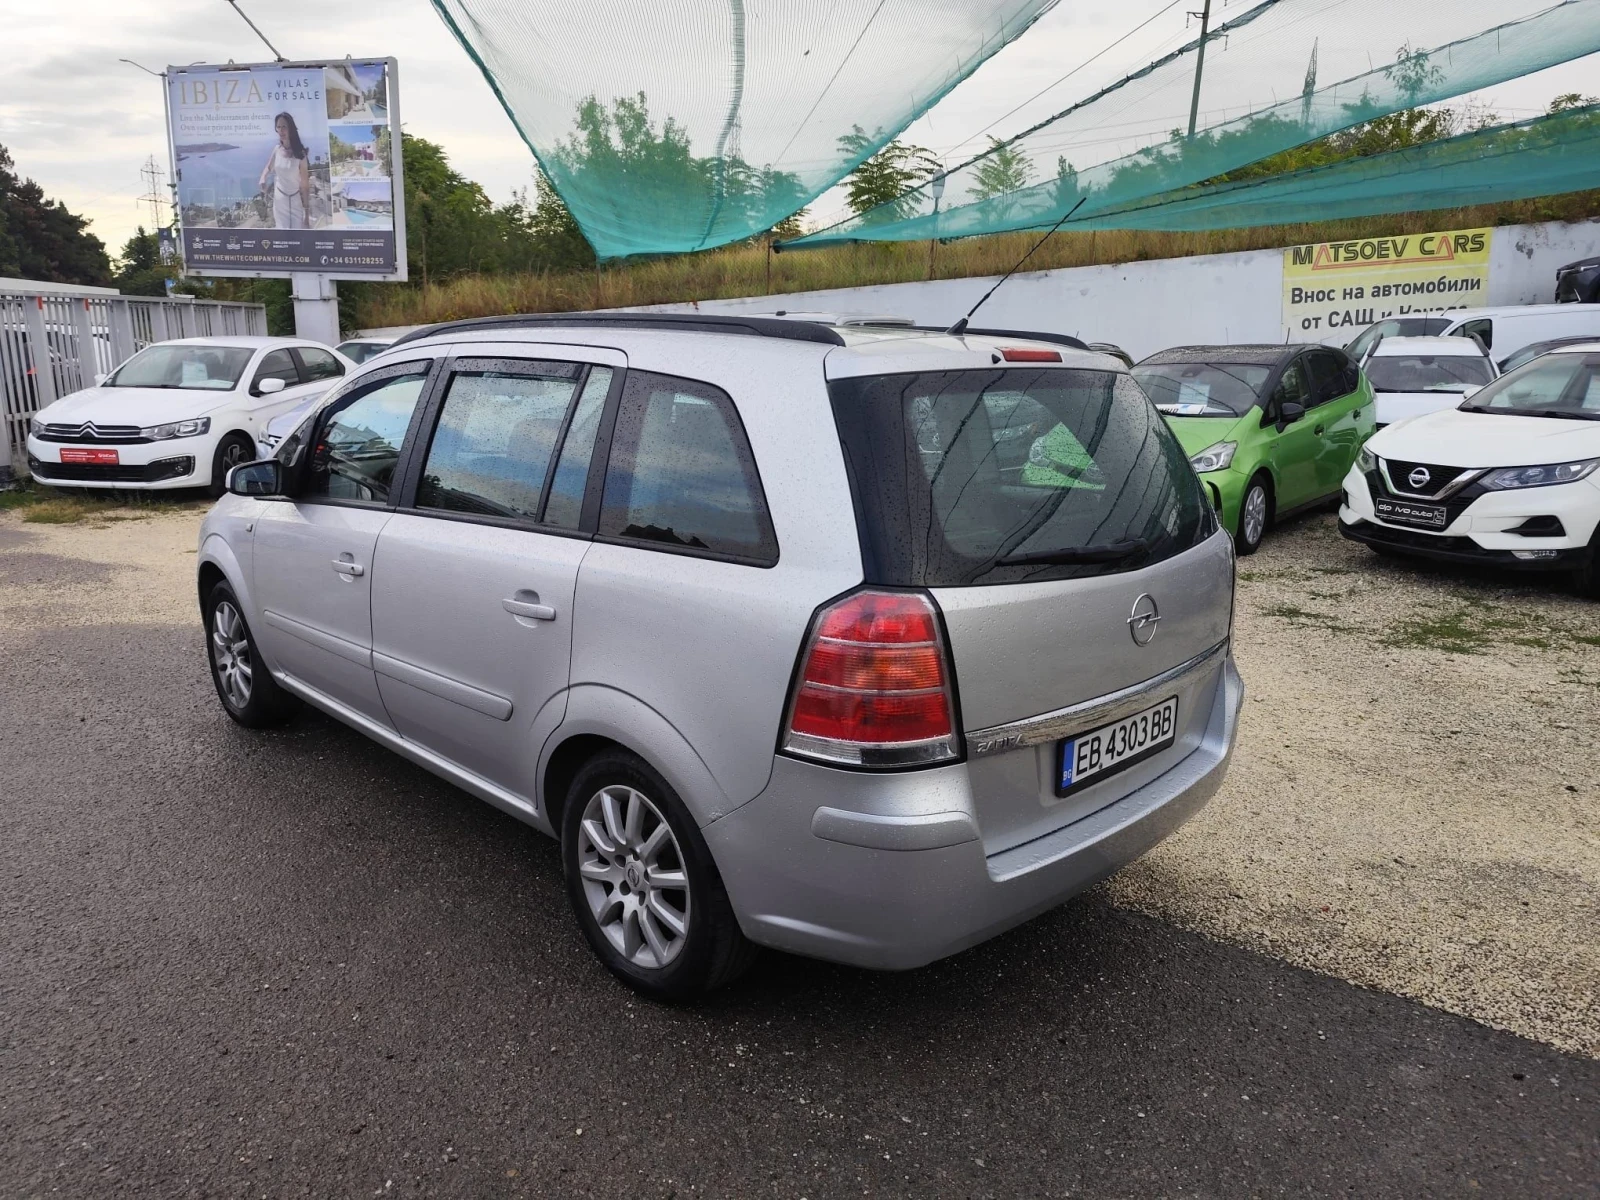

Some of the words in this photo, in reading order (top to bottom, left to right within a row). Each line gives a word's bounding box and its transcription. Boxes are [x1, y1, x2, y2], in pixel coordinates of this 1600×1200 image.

[275, 78, 309, 88] VILAS
[180, 79, 265, 105] IBIZA
[267, 92, 288, 101] FOR
[292, 91, 320, 100] SALE
[180, 114, 194, 122] Live
[205, 113, 250, 121] Mediterranean
[181, 123, 196, 131] Own
[211, 125, 233, 133] private
[1292, 238, 1409, 267] MATSOEV
[1419, 233, 1485, 257] CARS
[193, 254, 310, 263] WWW.THEWHITECOMPANYIBIZA.COM
[330, 256, 343, 264] +34
[344, 256, 384, 265] 631128255
[1291, 287, 1336, 304] Внос
[1342, 287, 1365, 301] на
[1370, 275, 1481, 298] автомобили
[1301, 316, 1322, 330] от
[1328, 308, 1375, 328] САЩ
[1411, 510, 1433, 518] auto
[1076, 735, 1101, 776] EB
[1105, 715, 1148, 761] 4303
[1150, 705, 1172, 742] BB
[1062, 768, 1073, 781] BG
